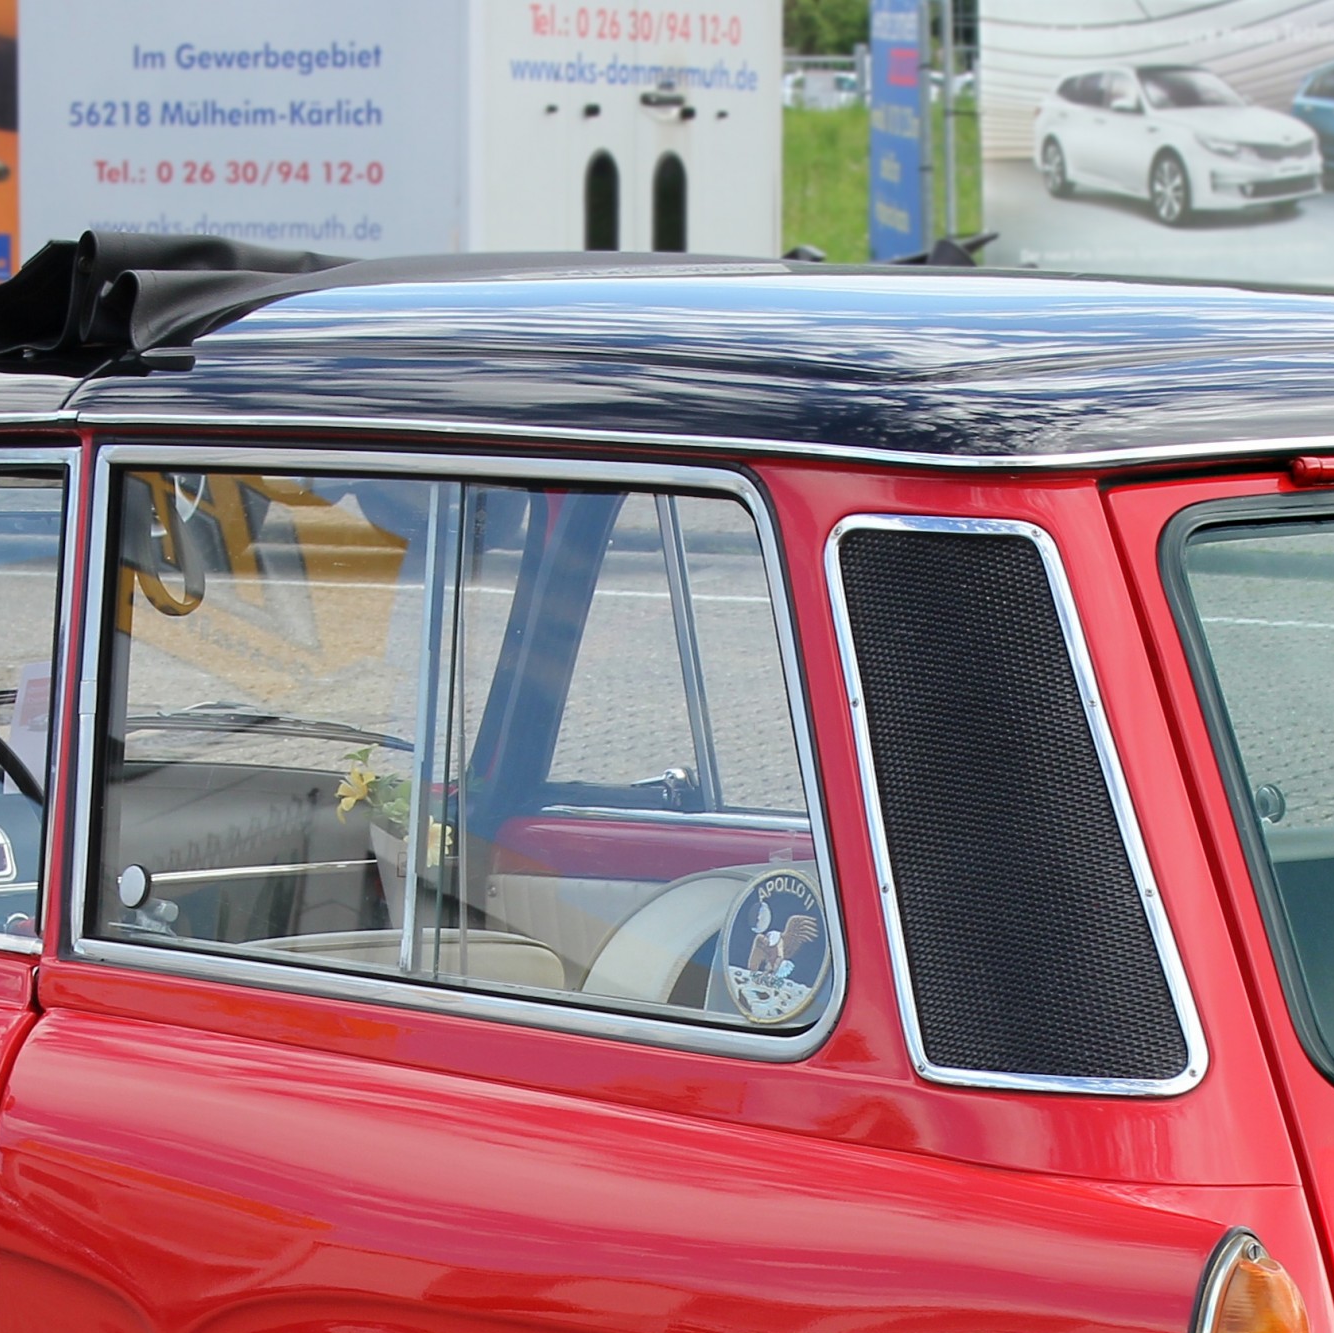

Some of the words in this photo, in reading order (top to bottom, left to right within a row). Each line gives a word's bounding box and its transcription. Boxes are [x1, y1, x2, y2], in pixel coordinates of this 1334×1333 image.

[530, 3, 569, 37] Tel.:
[576, 7, 589, 39] 0
[597, 8, 621, 40] 26
[628, 10, 691, 45] 30/94
[699, 13, 742, 46] 12-0
[133, 45, 165, 69] Im
[175, 42, 381, 75] Gewerbegebiet
[510, 52, 758, 91] www.aks-dommermuth.de
[69, 101, 151, 127] 56218
[160, 100, 383, 127] Mülheim-Kärlich
[94, 160, 146, 184] Tel.:
[156, 160, 173, 184] 0
[183, 160, 215, 184] 26
[226, 160, 310, 186] 30/94
[322, 160, 384, 185] 12-0
[88, 211, 383, 241] wwwaks-dommermuth.de
[757, 876, 806, 902] APOLLO
